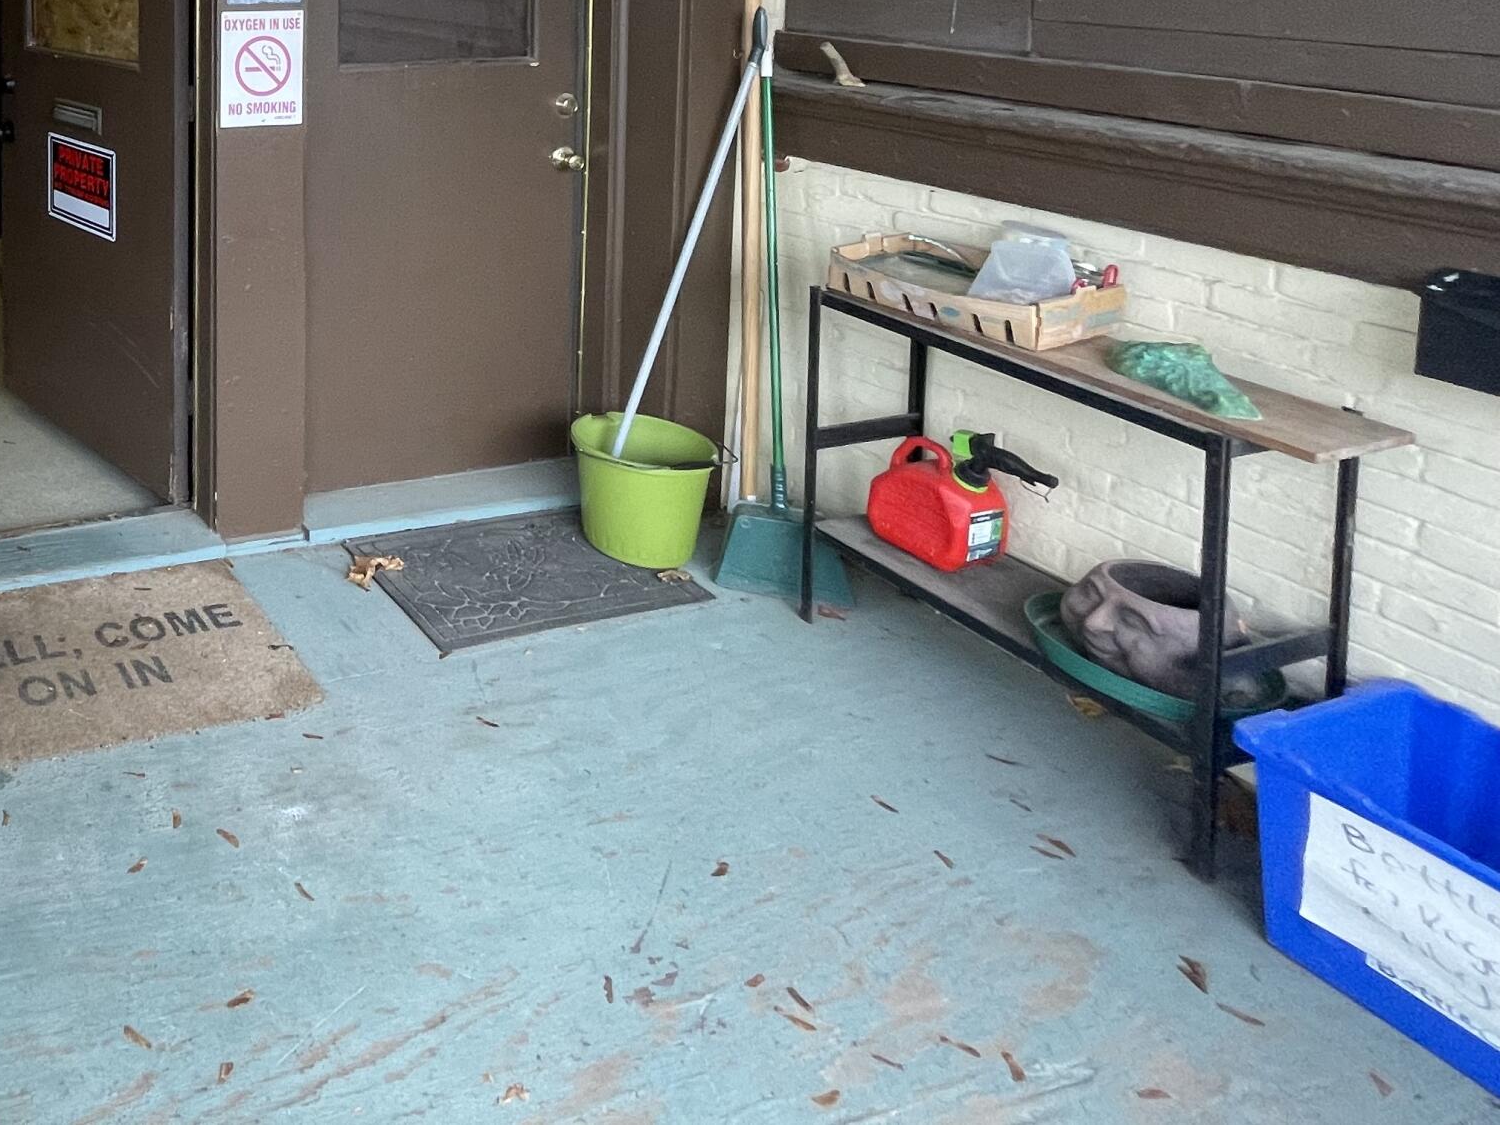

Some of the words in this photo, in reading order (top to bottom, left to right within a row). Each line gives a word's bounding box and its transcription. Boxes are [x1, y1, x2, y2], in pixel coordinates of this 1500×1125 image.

[224, 18, 266, 32] OXYGEN
[269, 18, 280, 30] IN
[282, 17, 301, 30] USE
[228, 103, 243, 116] NO
[246, 100, 297, 115] SMOKING
[58, 144, 105, 176] PRIVATE
[53, 162, 110, 197] PROPERTY
[94, 603, 244, 649] COME
[17, 669, 98, 706] ON
[113, 655, 174, 690] IN
